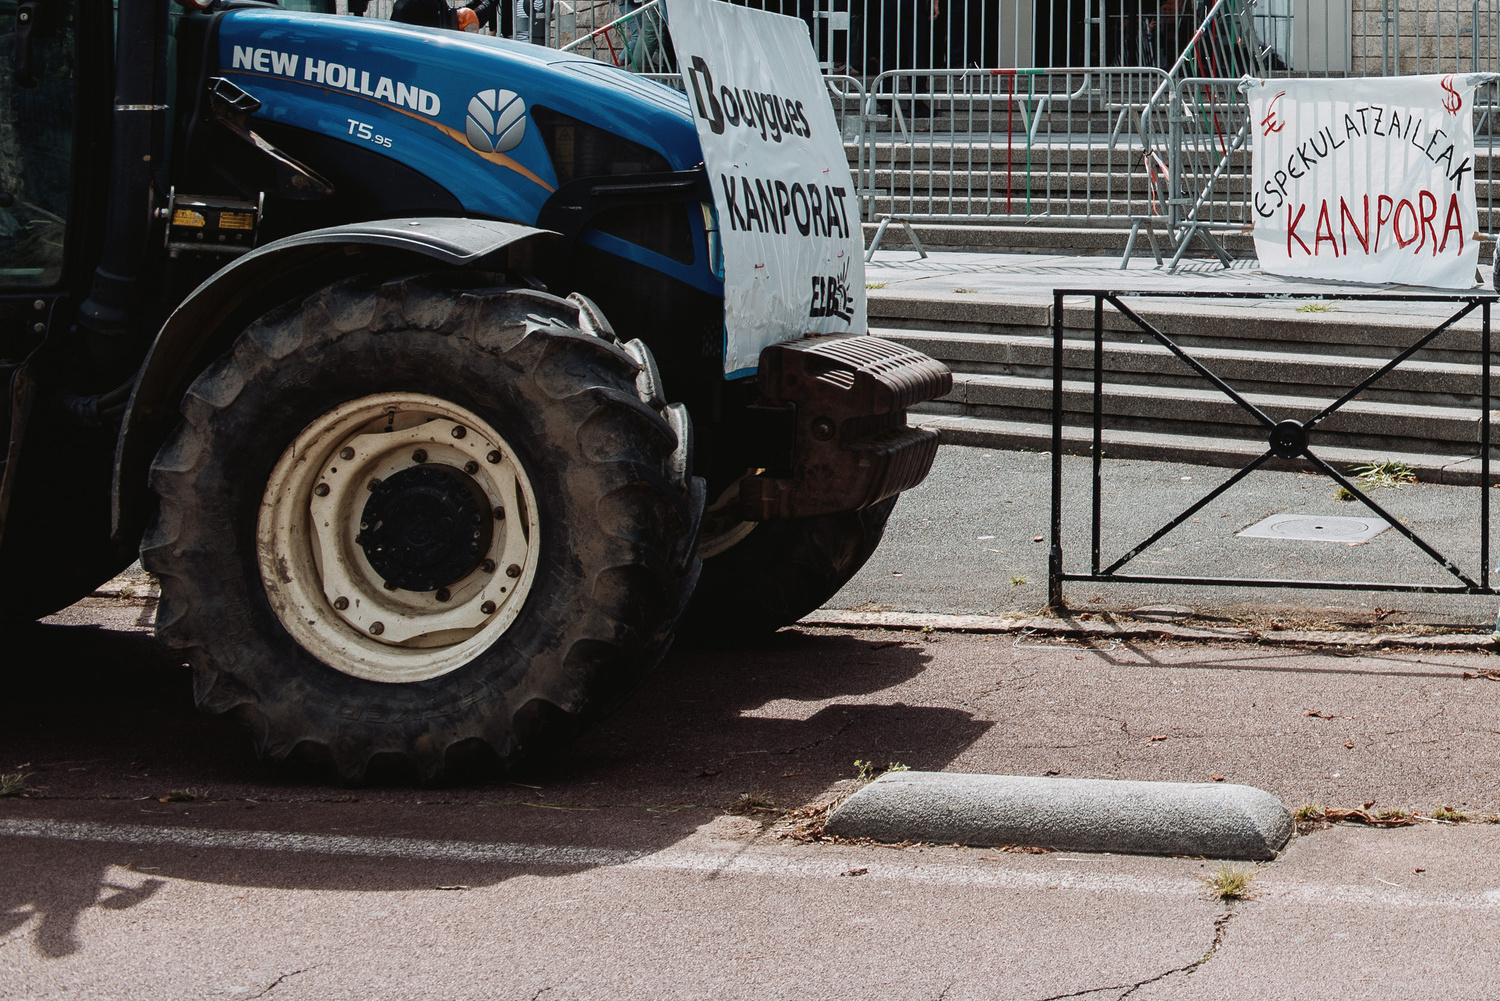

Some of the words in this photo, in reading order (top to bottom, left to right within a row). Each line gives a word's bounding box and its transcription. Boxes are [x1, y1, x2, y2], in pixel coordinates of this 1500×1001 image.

[232, 45, 299, 77] NEW
[304, 57, 441, 117] HOLLAND
[687, 55, 811, 143] Bouygues
[1254, 106, 1472, 218] ESPEKULATZAILEAK
[721, 173, 850, 239] KANPORAT
[1287, 190, 1465, 259] KANPORA
